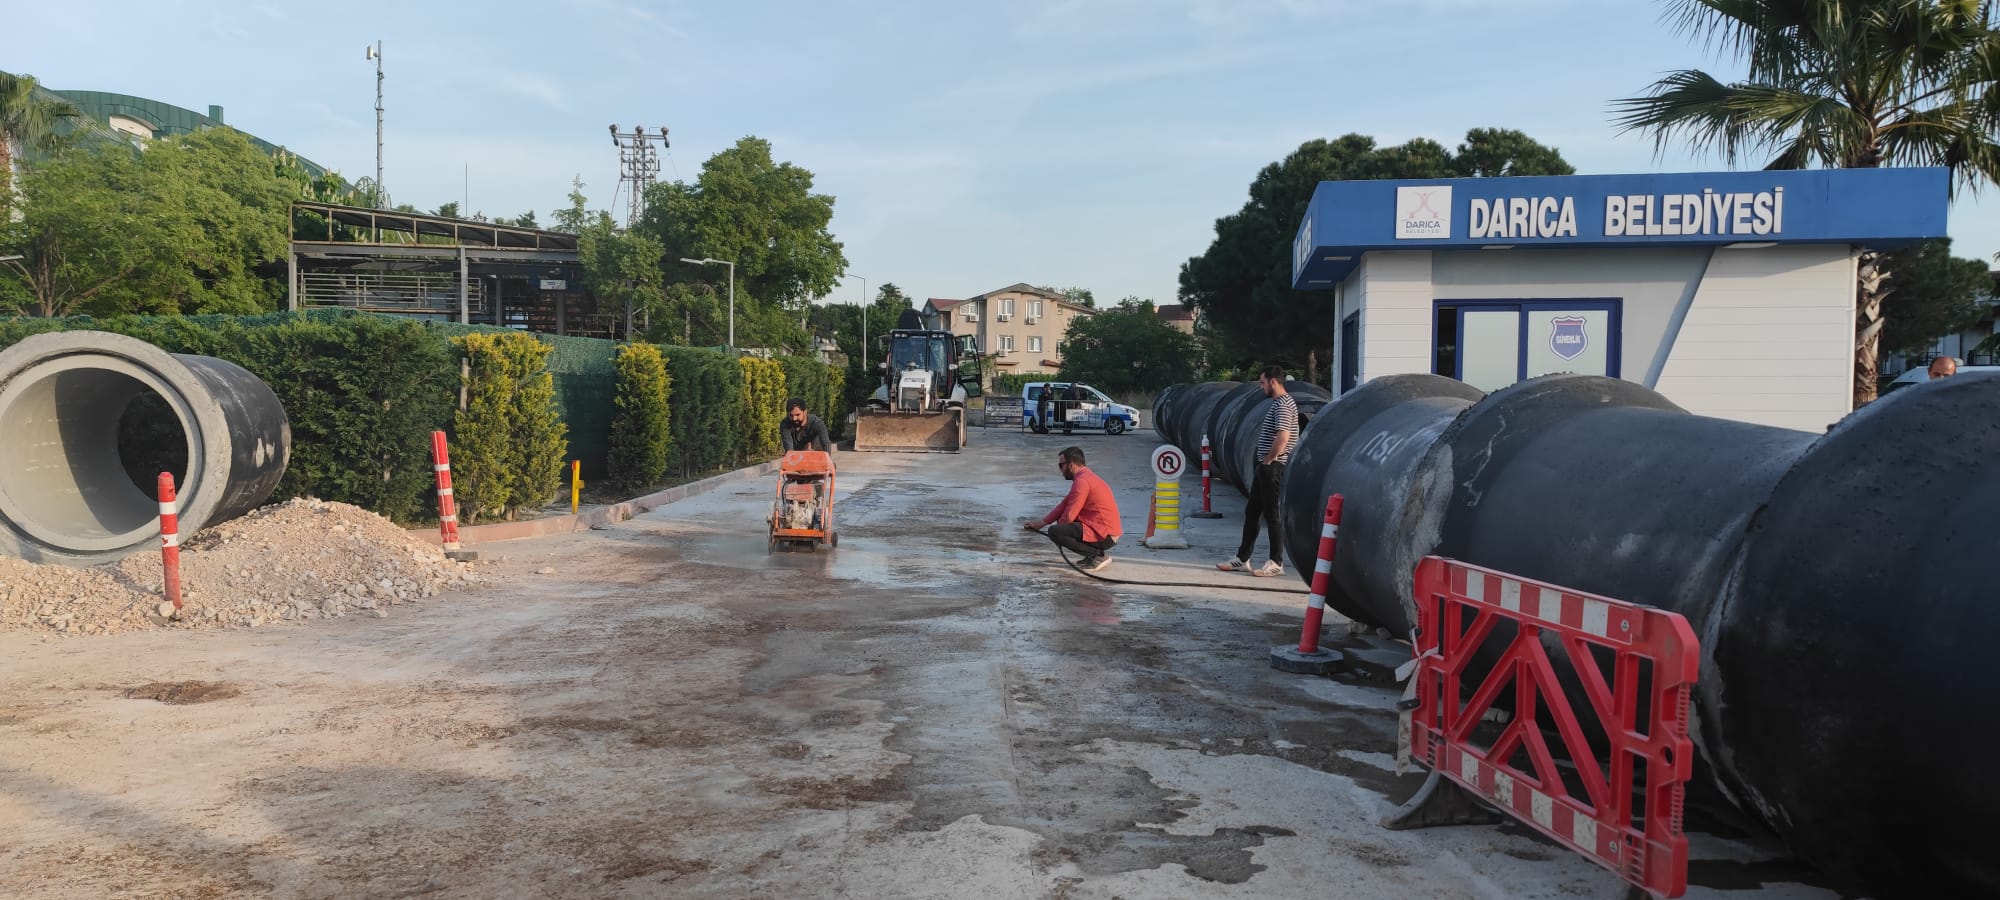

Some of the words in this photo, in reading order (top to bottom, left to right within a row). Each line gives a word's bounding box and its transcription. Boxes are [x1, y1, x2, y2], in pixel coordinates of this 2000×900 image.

[1405, 220, 1441, 229] DARICA
[1470, 196, 1577, 239] DARICA
[1605, 186, 1784, 237] BELEDİYESİ
